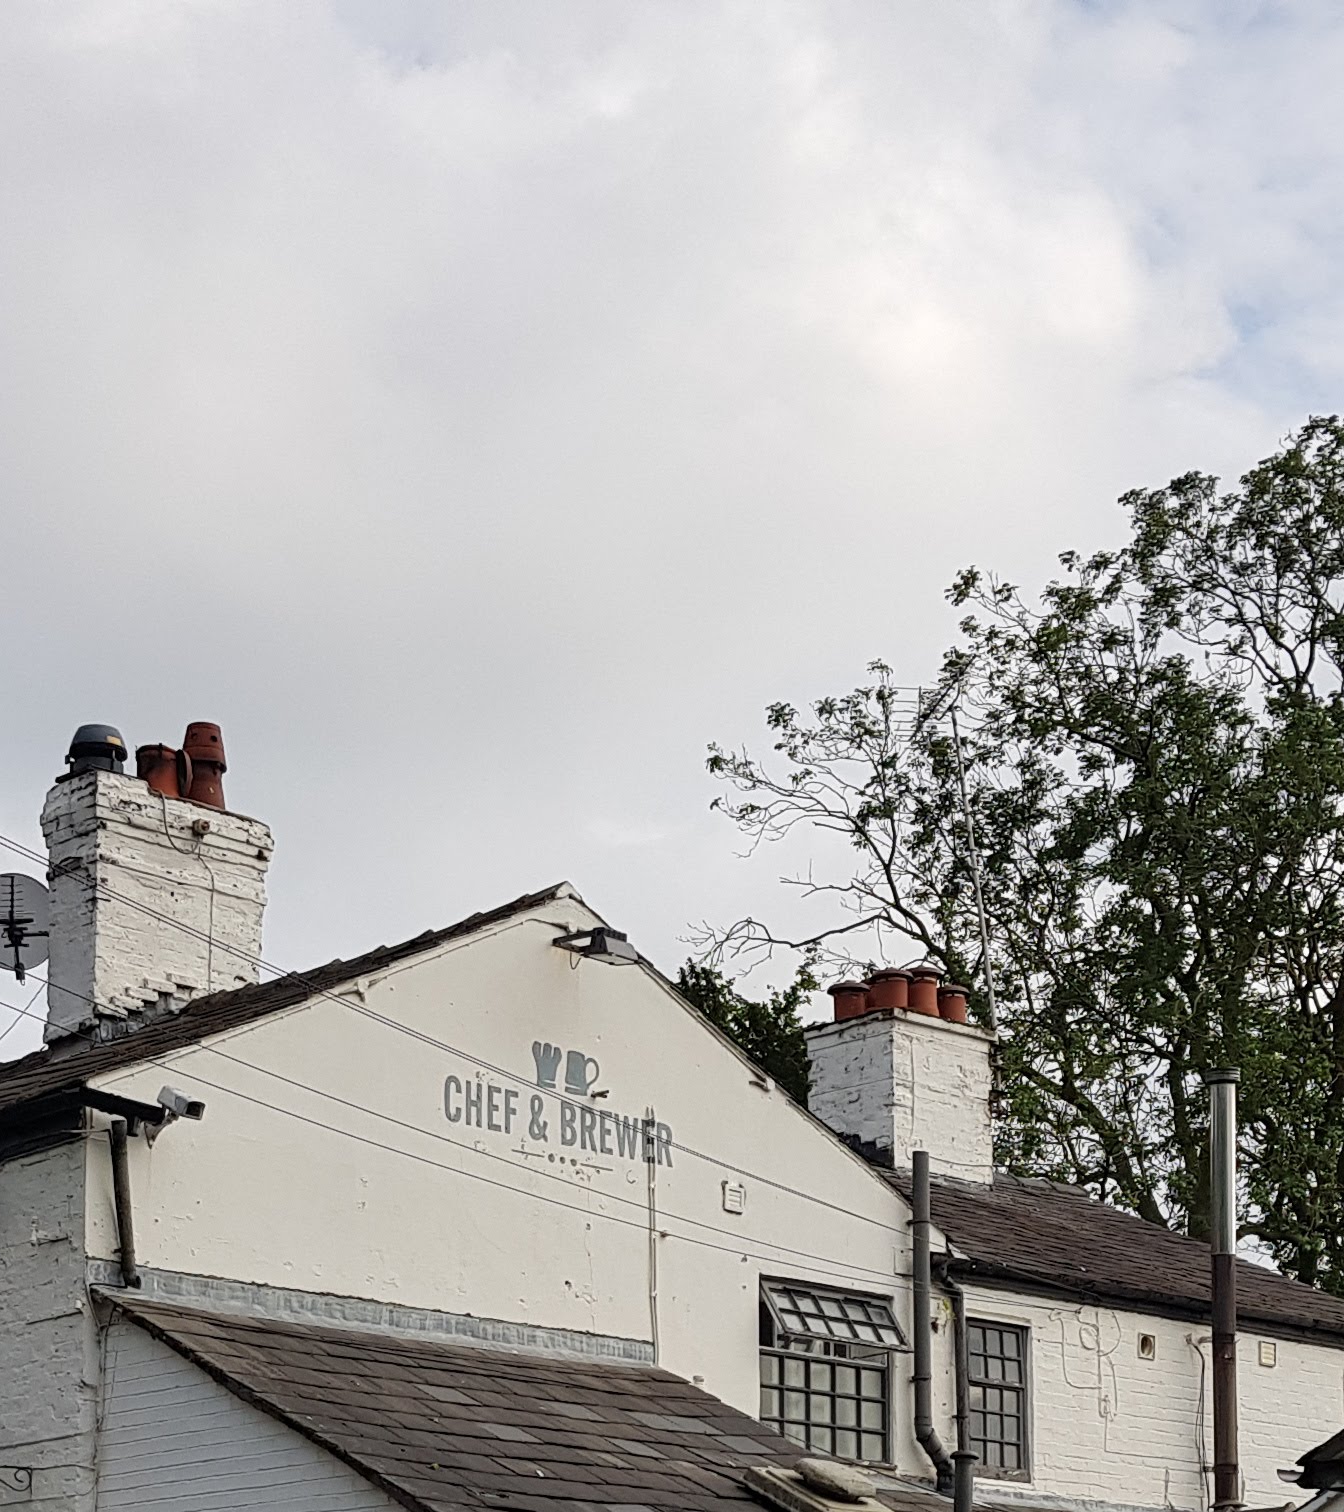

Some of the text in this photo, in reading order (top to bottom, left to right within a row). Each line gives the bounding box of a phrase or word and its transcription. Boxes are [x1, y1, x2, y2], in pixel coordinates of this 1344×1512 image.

[444, 1075, 674, 1168] CHEF & BREWER
